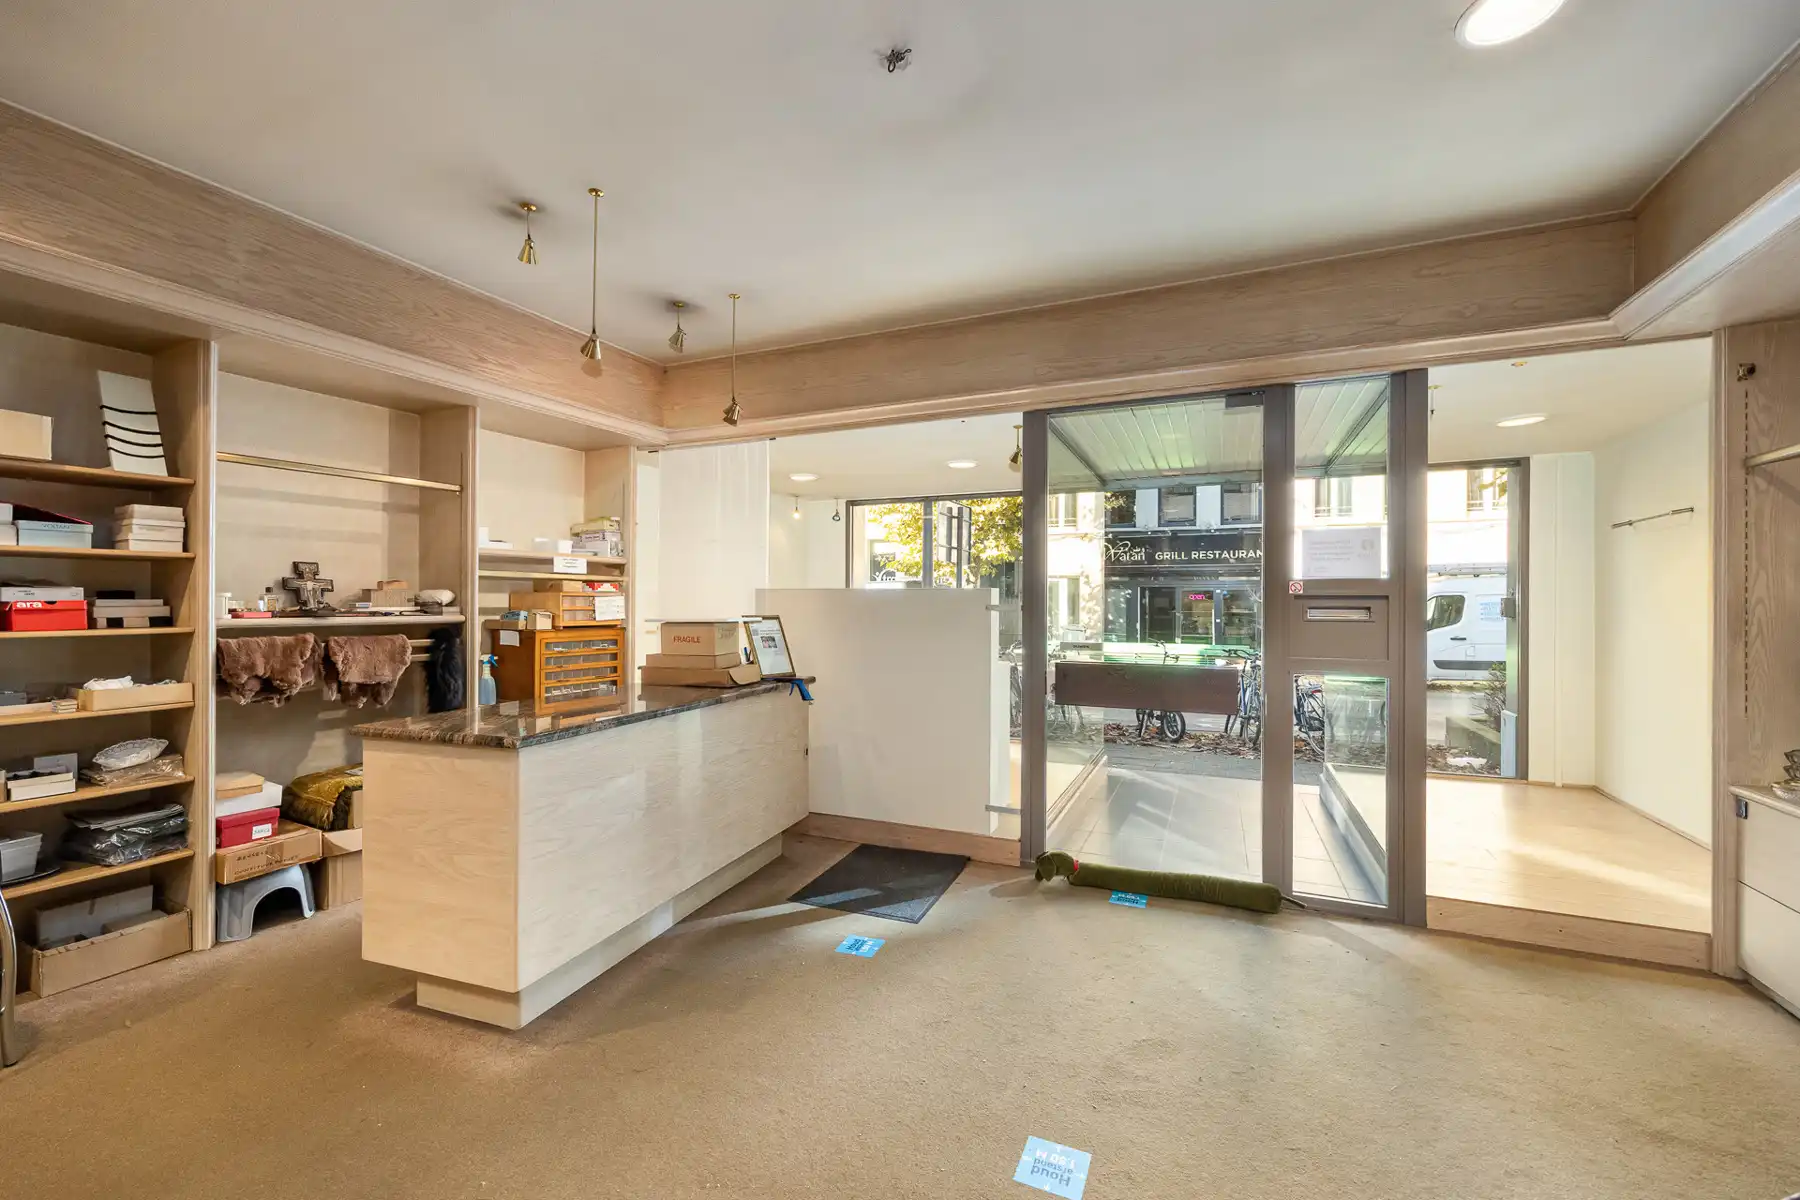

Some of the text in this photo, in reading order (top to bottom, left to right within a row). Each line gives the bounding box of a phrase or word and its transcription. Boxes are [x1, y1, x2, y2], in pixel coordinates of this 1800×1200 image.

[1155, 551, 1188, 560] GRILL
[16, 601, 43, 609] ara
[673, 635, 701, 644] FRAGILE
[1030, 1164, 1071, 1187] Houd
